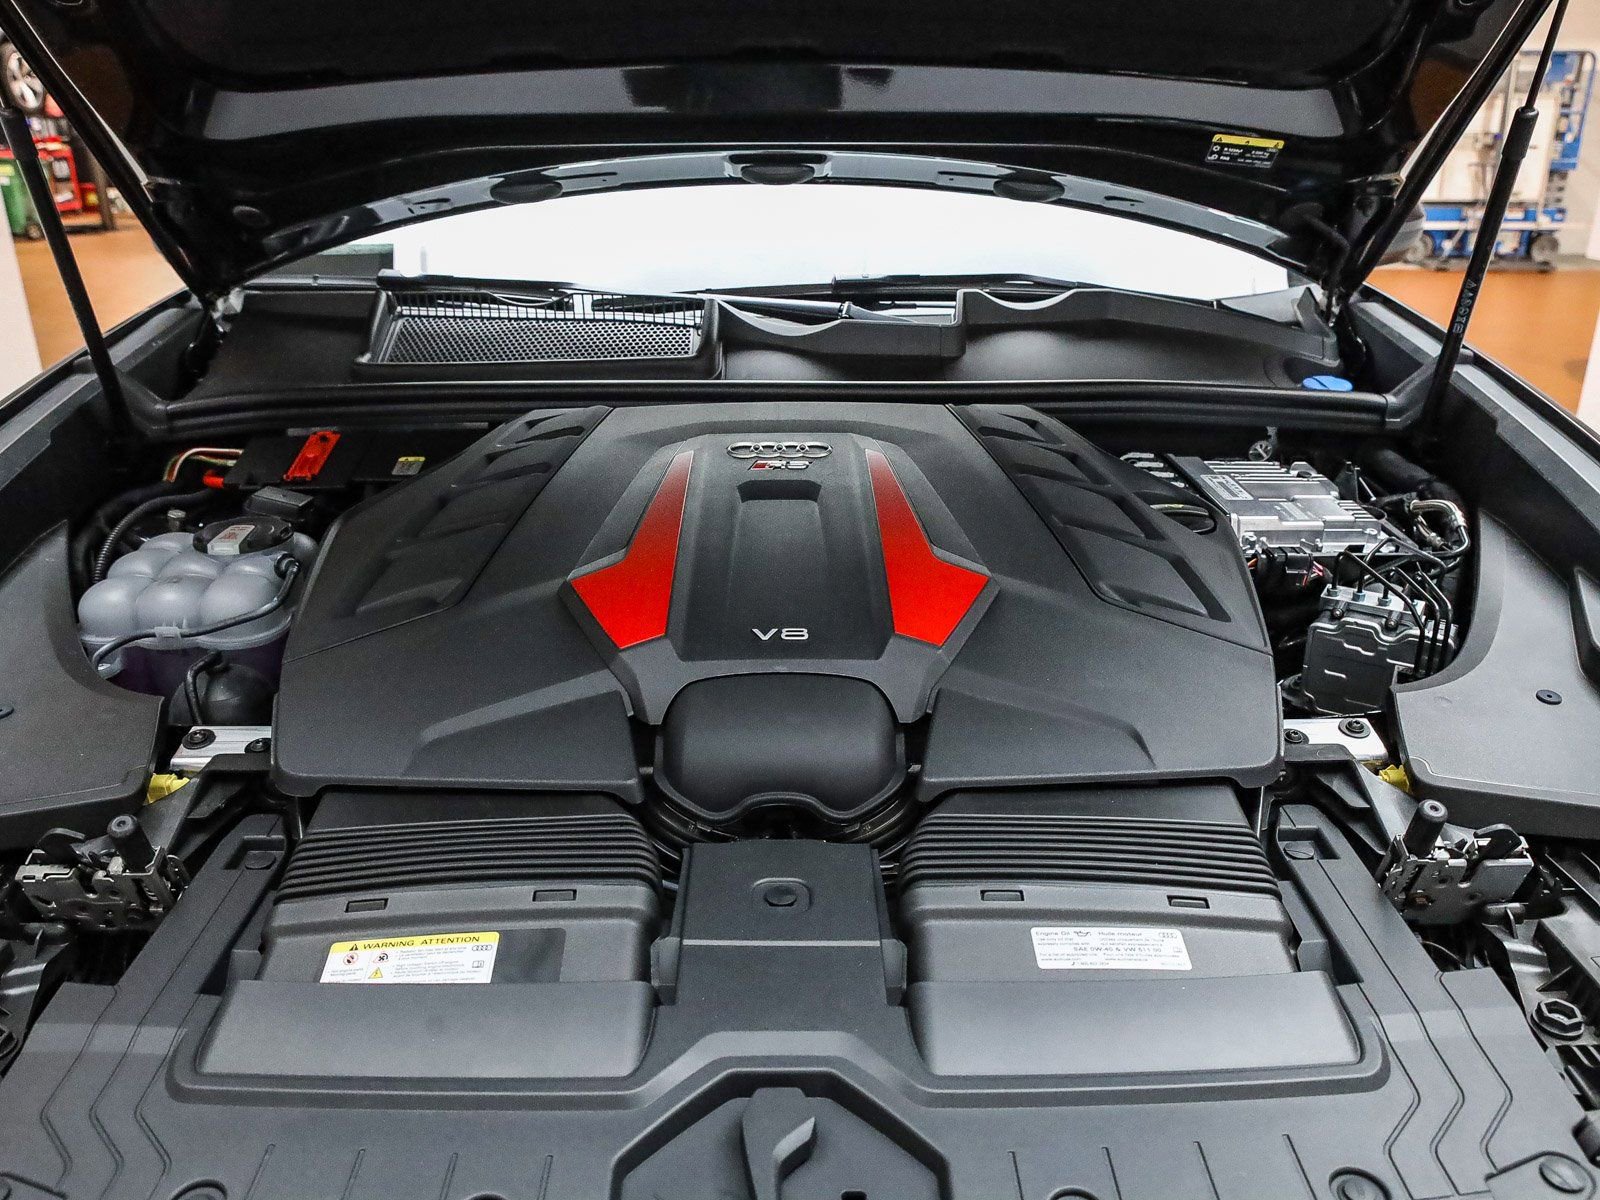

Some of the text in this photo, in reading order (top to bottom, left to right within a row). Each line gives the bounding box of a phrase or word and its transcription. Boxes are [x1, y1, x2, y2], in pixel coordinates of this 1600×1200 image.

[751, 627, 809, 640] V8
[363, 936, 480, 950] WARNING ATTENTION
